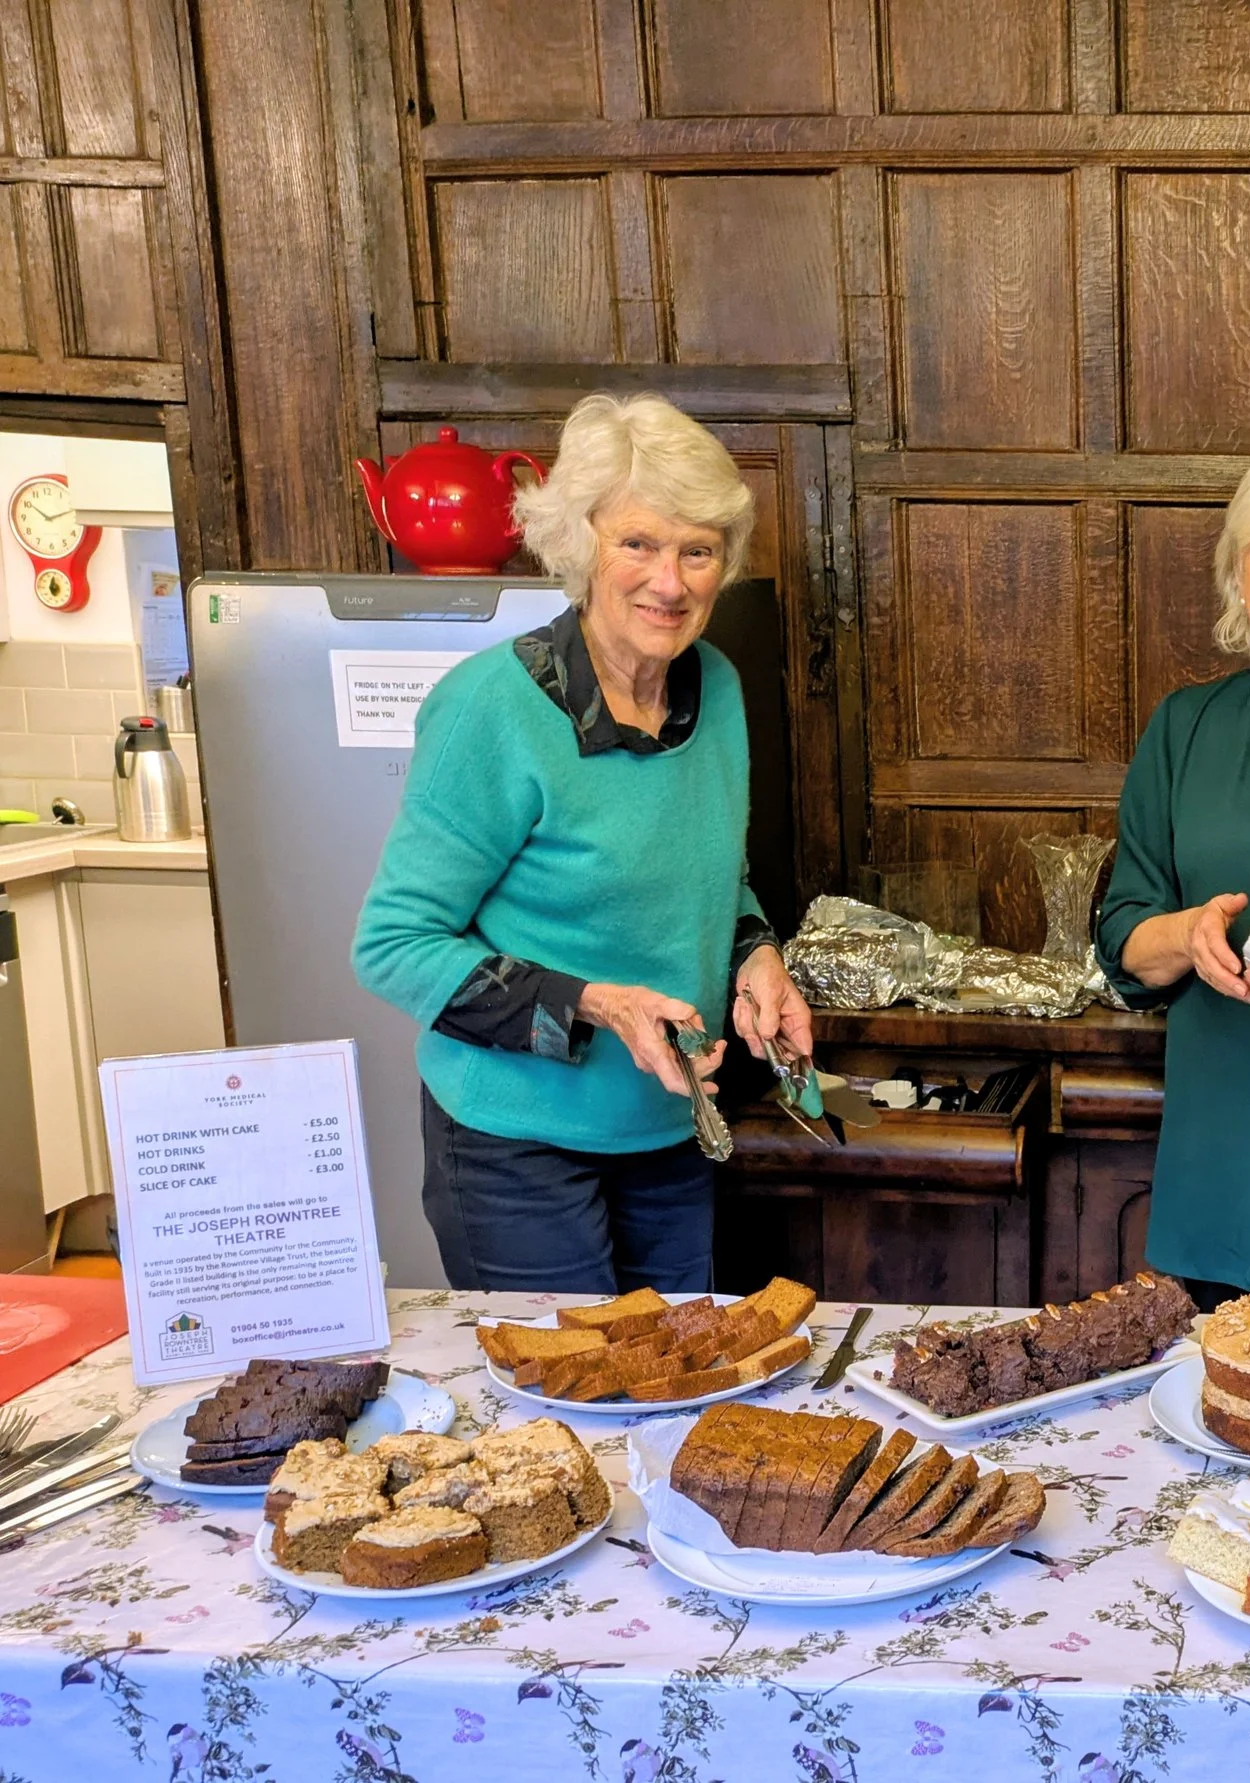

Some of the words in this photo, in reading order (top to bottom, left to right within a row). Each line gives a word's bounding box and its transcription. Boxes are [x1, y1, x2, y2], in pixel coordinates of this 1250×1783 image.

[63, 539, 67, 547] 5
[136, 1133, 159, 1143] HOT
[162, 1130, 197, 1141] DRINK
[199, 1127, 229, 1137] WITH
[231, 1124, 259, 1134] CAKE
[309, 1116, 338, 1127] £5.00
[137, 1149, 161, 1159] HOT
[164, 1145, 204, 1157] DRINKS
[311, 1132, 339, 1142] £2.50
[138, 1164, 168, 1176] COLD
[170, 1161, 205, 1172] DRINK
[314, 1147, 342, 1158] £1.00
[139, 1180, 168, 1192] SLICE
[171, 1178, 186, 1188] OF
[189, 1175, 217, 1186] CAKE
[315, 1162, 344, 1173] £3.00
[179, 1207, 220, 1219] proceeds
[223, 1204, 244, 1213] from
[246, 1202, 260, 1210] the
[263, 1199, 286, 1208] sales
[305, 1197, 316, 1205] go
[153, 1223, 183, 1237] THE
[188, 1216, 249, 1233] JOSEPH
[254, 1206, 340, 1225] ROWNTREE
[214, 1228, 285, 1246] THEATRE
[144, 1269, 161, 1277] Built
[173, 1266, 192, 1274] 1935
[194, 1264, 204, 1273] by
[206, 1262, 219, 1270] the
[221, 1258, 258, 1268] Rowntree
[260, 1254, 285, 1264] Village
[287, 1252, 308, 1261] Trust,
[324, 1246, 357, 1255] beautiful
[175, 1253, 211, 1265] operated
[213, 1252, 222, 1260] by
[239, 1245, 282, 1257] Community
[148, 1289, 174, 1299] facility
[192, 1284, 219, 1294] serving
[232, 1278, 260, 1289] original
[263, 1275, 295, 1285] purpose:
[325, 1267, 344, 1277] place
[149, 1279, 173, 1287] Grade
[182, 1275, 203, 1283] listed
[205, 1271, 236, 1282] building
[261, 1266, 277, 1275] only
[279, 1261, 316, 1272] remaining
[318, 1256, 354, 1266] Rowntree
[165, 1329, 207, 1341] JOSEPH
[231, 1323, 256, 1332] 01904
[259, 1321, 269, 1329] 50
[273, 1318, 292, 1327] 1935
[232, 1322, 344, 1345] boxoffice@jrtheatre.co.uk
[163, 1336, 207, 1347] ROWNTREE
[165, 1343, 208, 1354] THEATRE
